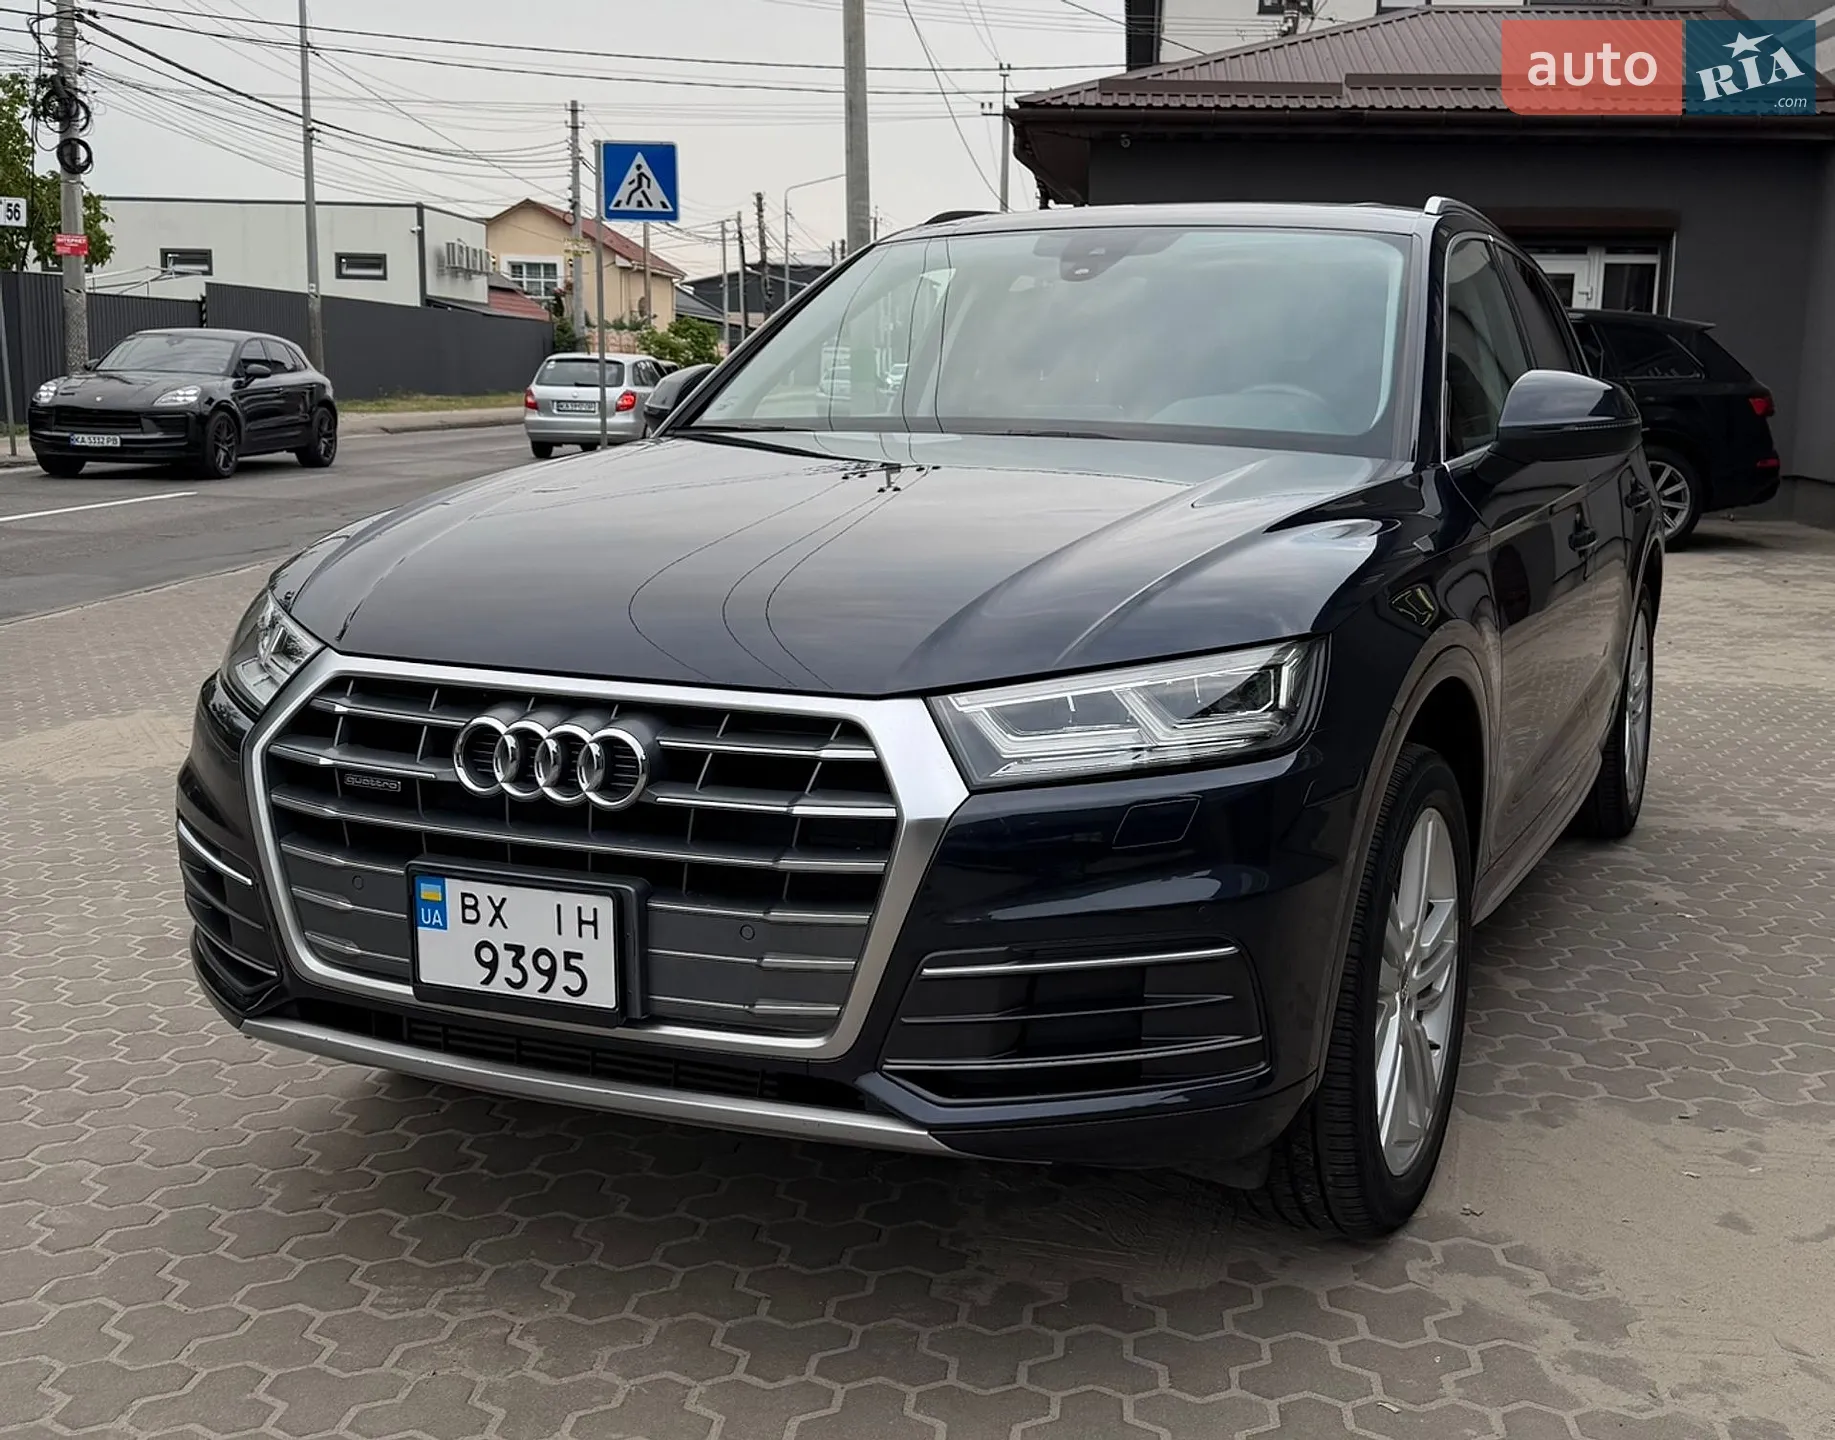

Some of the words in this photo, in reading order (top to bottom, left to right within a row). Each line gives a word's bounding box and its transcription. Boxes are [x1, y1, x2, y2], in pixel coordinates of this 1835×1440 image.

[6, 203, 21, 221] 56
[345, 775, 398, 790] quattro
[420, 907, 443, 927] UA
[460, 891, 508, 930] BX
[556, 903, 598, 940] IH
[474, 940, 588, 998] 9395
